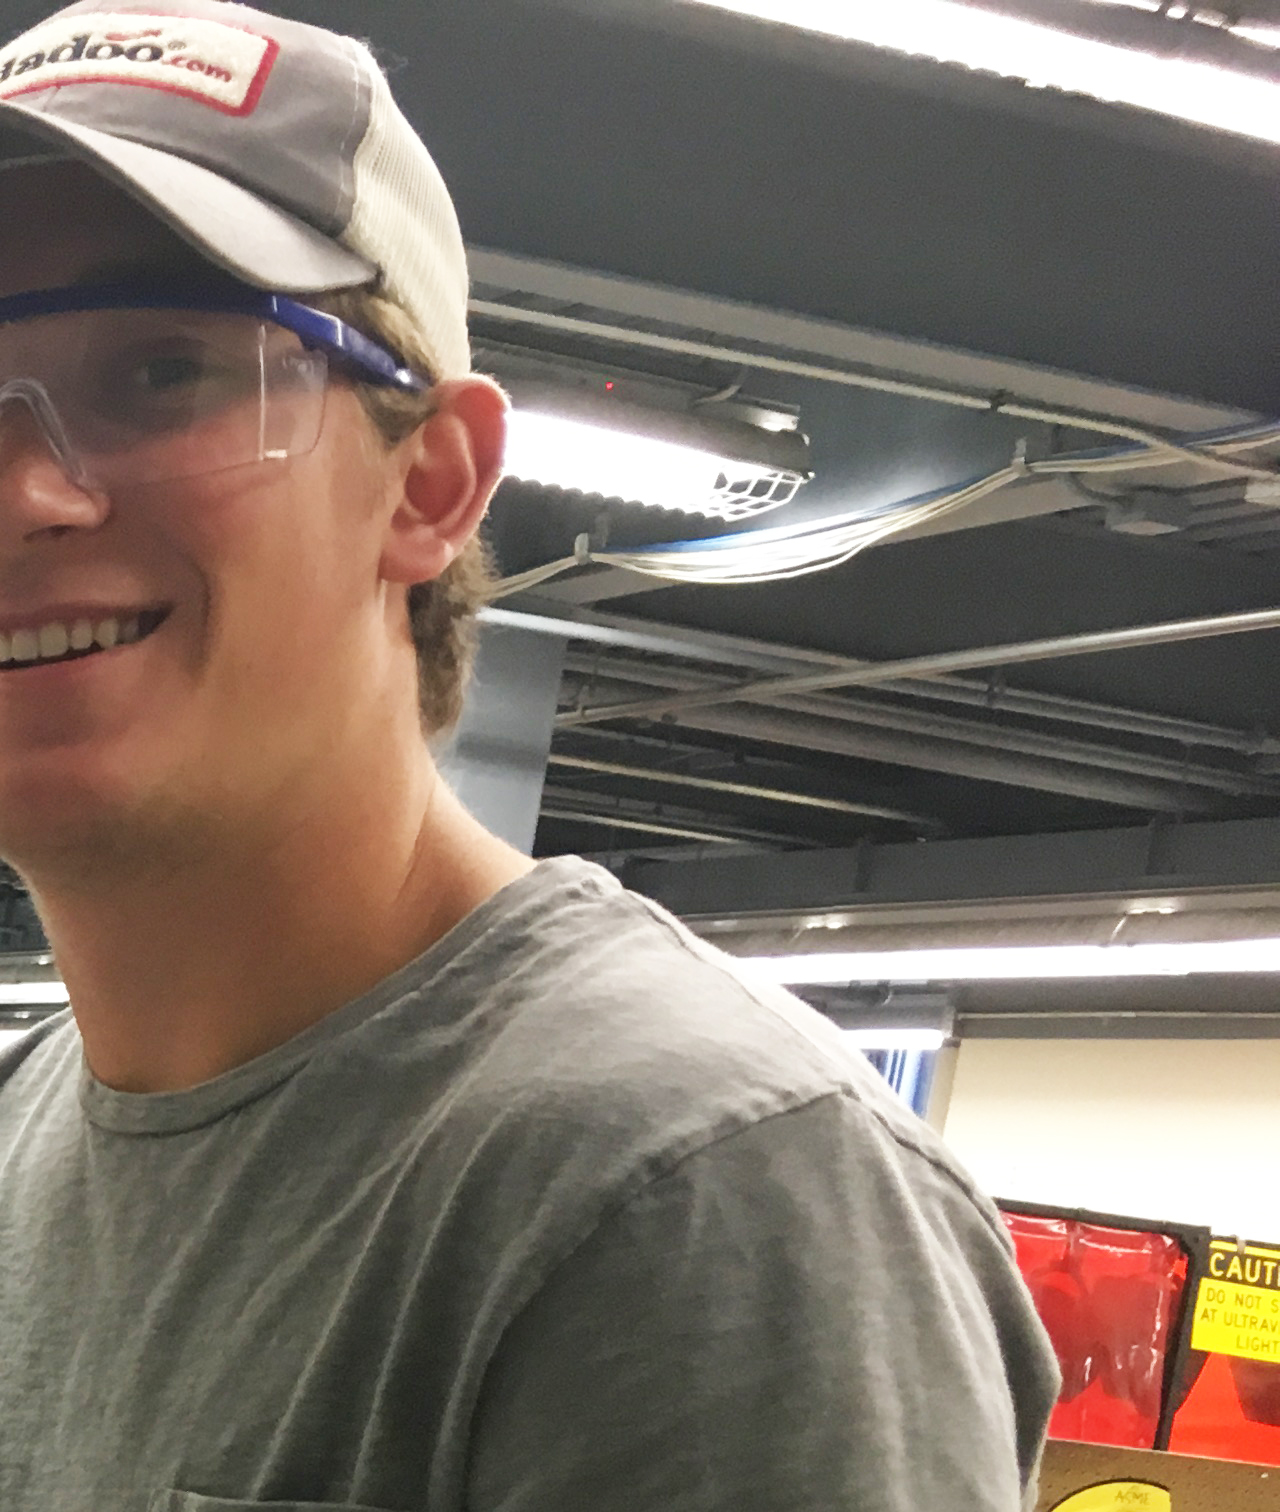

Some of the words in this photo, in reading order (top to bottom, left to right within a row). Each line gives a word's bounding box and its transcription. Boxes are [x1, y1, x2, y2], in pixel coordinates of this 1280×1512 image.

[1206, 1287, 1226, 1305] DO
[1235, 1292, 1262, 1310] NOT
[1201, 1307, 1217, 1323] AT
[1236, 1335, 1280, 1355] LIGHT
